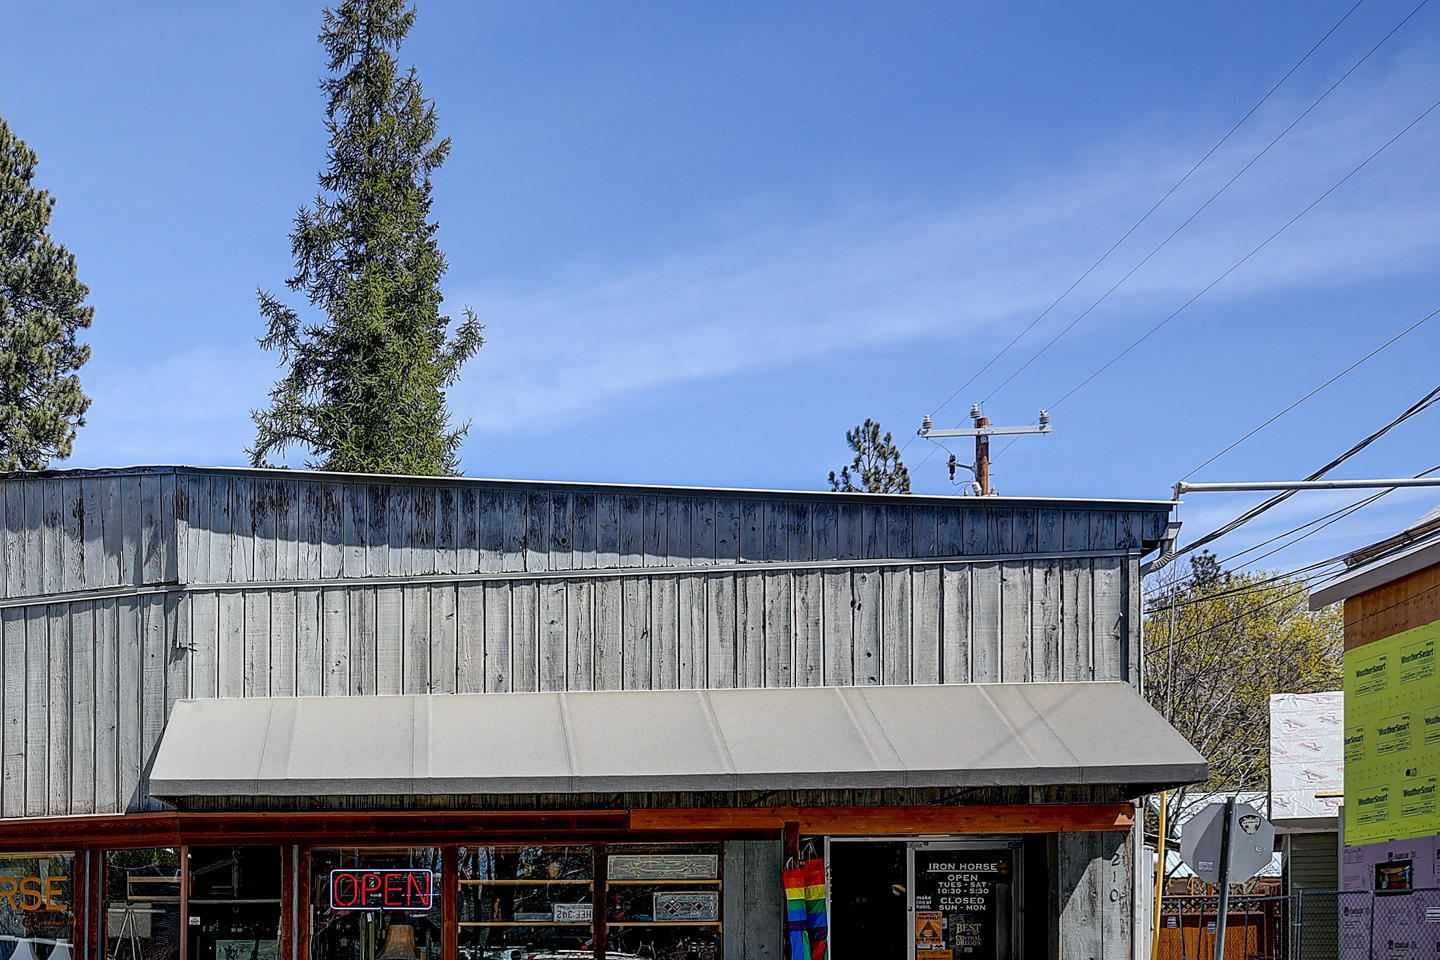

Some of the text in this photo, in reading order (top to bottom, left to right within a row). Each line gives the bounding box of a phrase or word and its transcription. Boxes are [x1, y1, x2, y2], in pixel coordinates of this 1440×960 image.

[334, 873, 430, 906] OPEN
[940, 897, 985, 905] CLOSED
[956, 923, 981, 934] BEST
